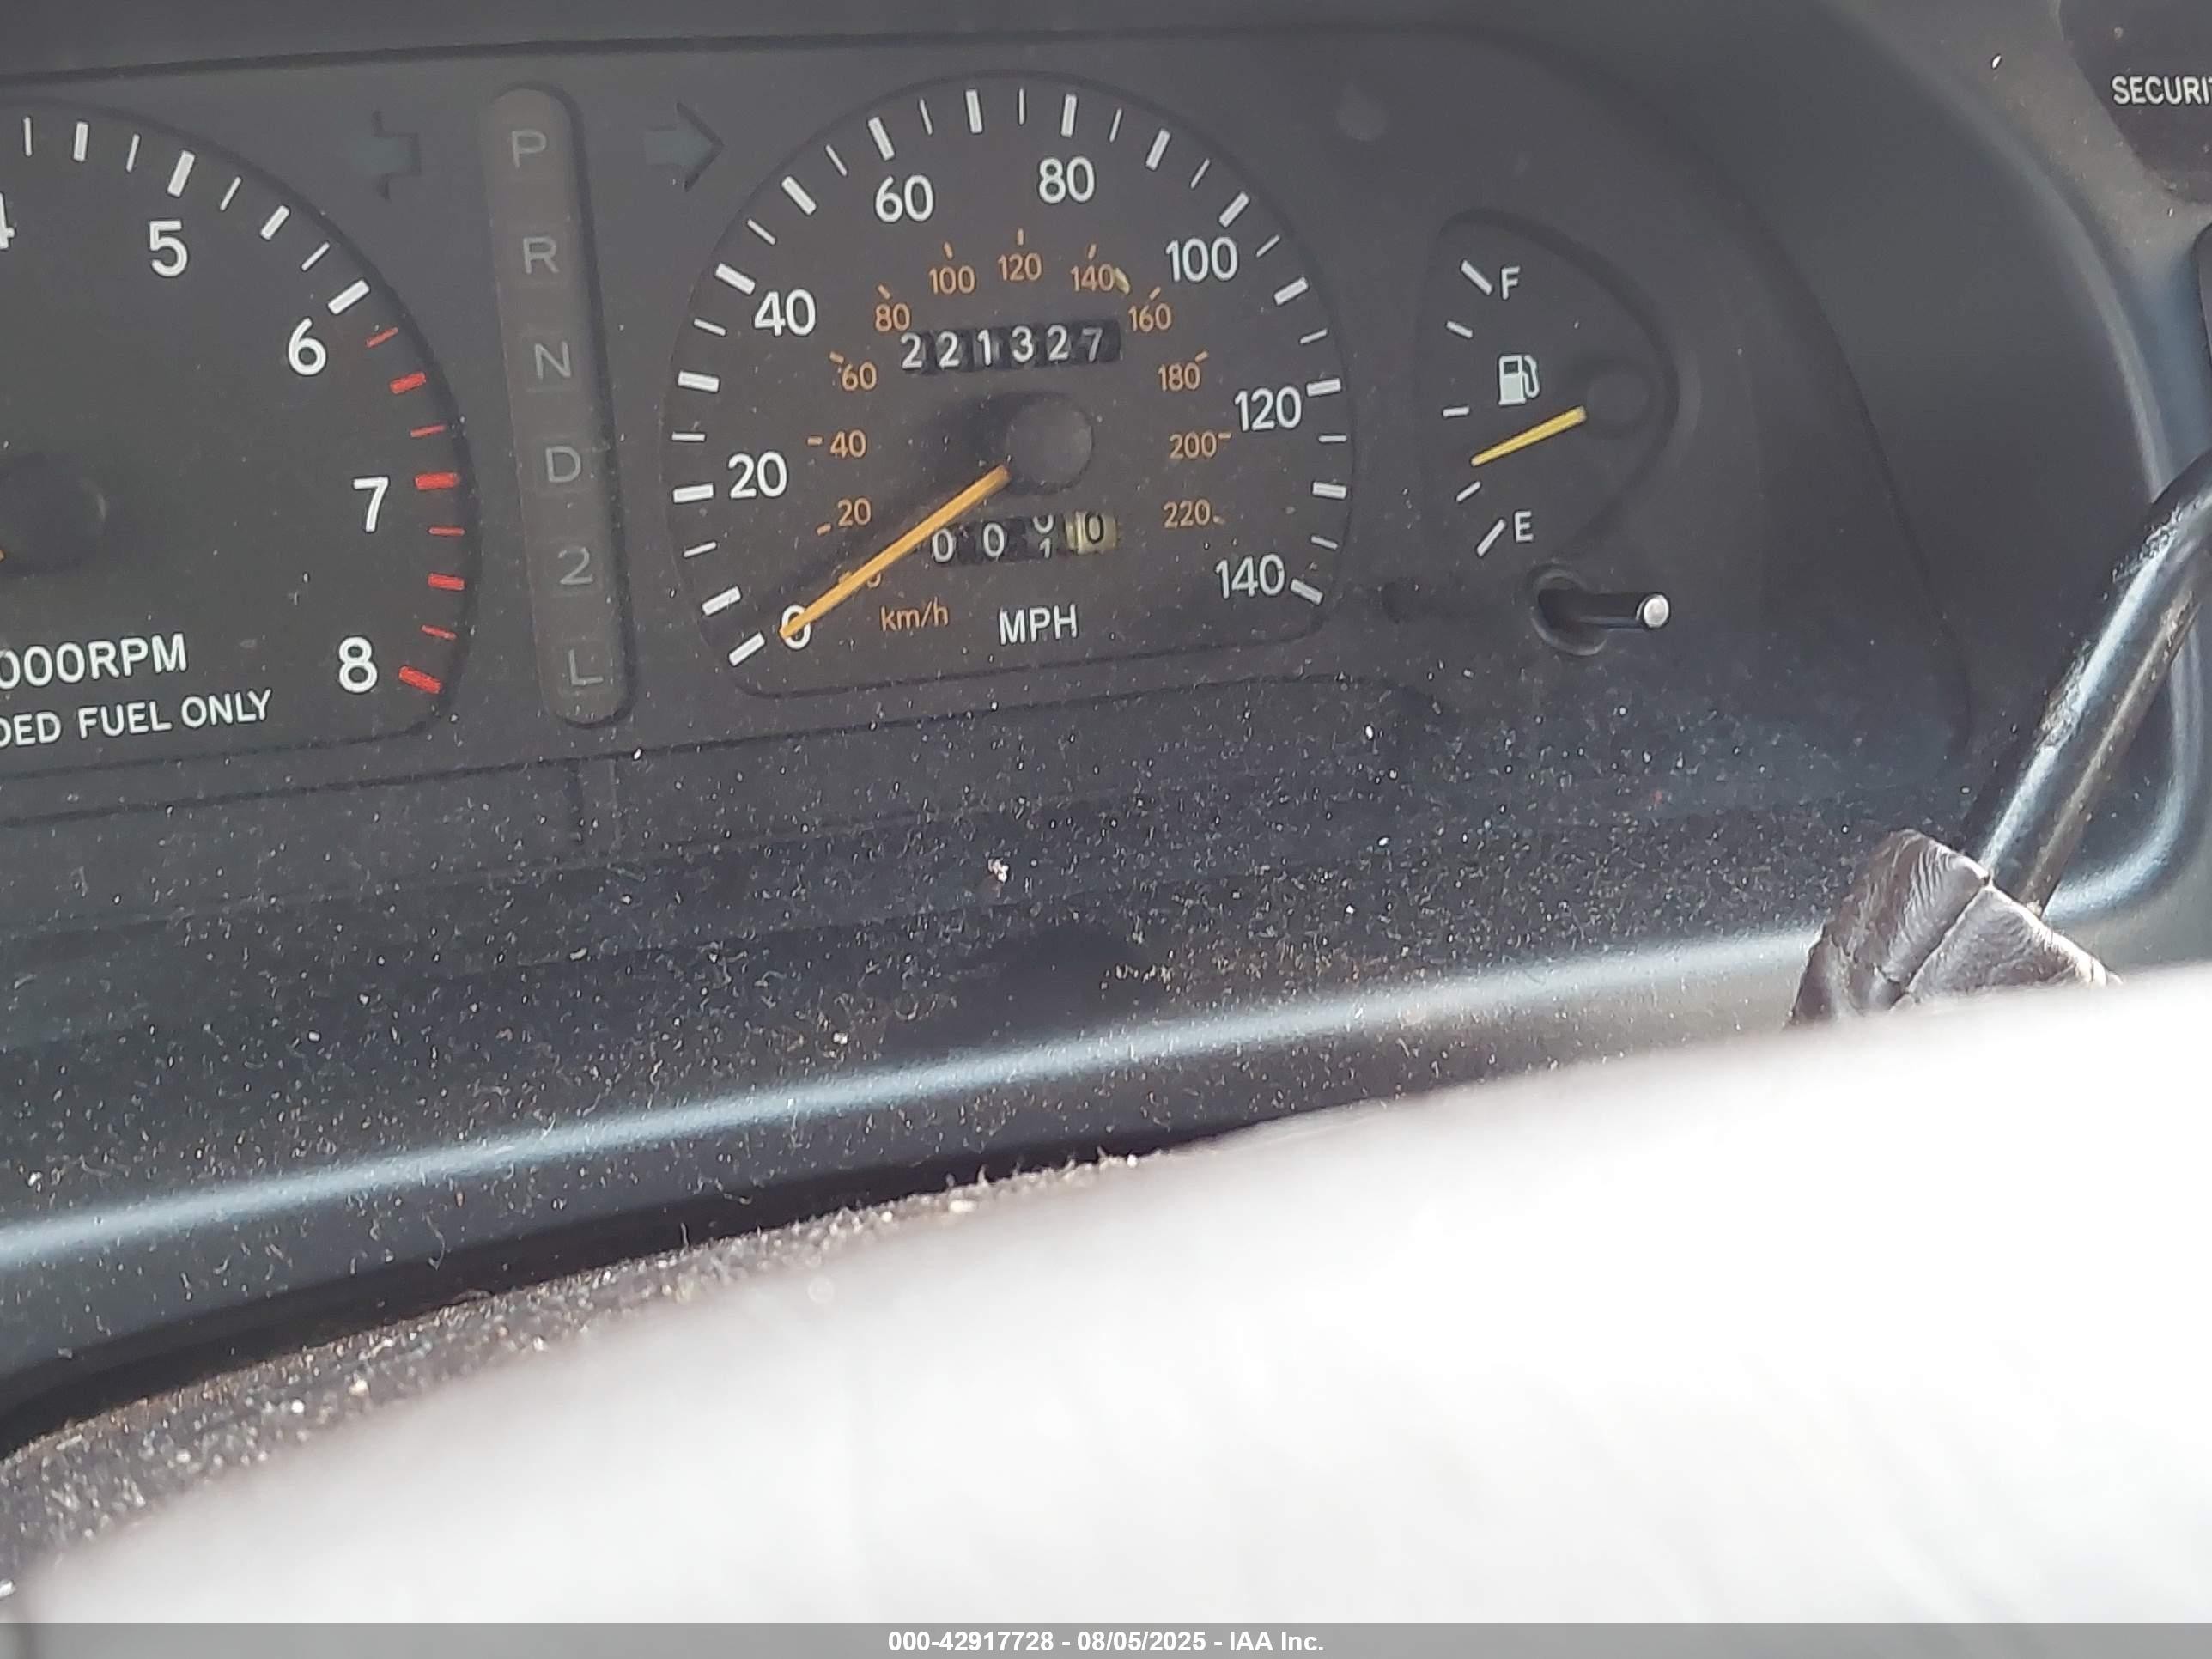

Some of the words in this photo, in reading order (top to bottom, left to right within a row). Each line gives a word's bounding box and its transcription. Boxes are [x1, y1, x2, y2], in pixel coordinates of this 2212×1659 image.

[2112, 76, 2212, 105] SECURI
[510, 130, 547, 167] P
[875, 174, 934, 222] 60
[1038, 157, 1095, 203] 80
[149, 220, 188, 277] 5
[522, 237, 559, 274] R
[998, 252, 1042, 281] 120
[1165, 236, 1238, 283] 100
[928, 265, 975, 295] 100
[1070, 264, 1114, 292] 140
[1501, 266, 1520, 300] F
[754, 289, 817, 337] 40
[875, 303, 911, 332] 80
[1127, 302, 1172, 331] 160
[288, 318, 326, 375] 6
[535, 343, 571, 378] N
[900, 325, 1103, 370] 221327
[841, 361, 877, 391] 60
[1157, 362, 1201, 391] 180
[1234, 386, 1302, 431] 120
[830, 429, 867, 459] 40
[1169, 433, 1218, 459] 200
[545, 446, 581, 483] D
[728, 450, 787, 499] 20
[353, 477, 388, 532] 7
[837, 497, 872, 527] 20
[1164, 499, 1211, 528] 220
[1514, 511, 1534, 542] E
[558, 546, 593, 586] 2
[1215, 554, 1285, 599] 140
[880, 598, 949, 631] km/h
[999, 604, 1078, 645] MPH
[338, 636, 378, 693] 8
[568, 649, 603, 686] L
[78, 701, 172, 738] FUEL
[181, 688, 272, 729] ONLY
